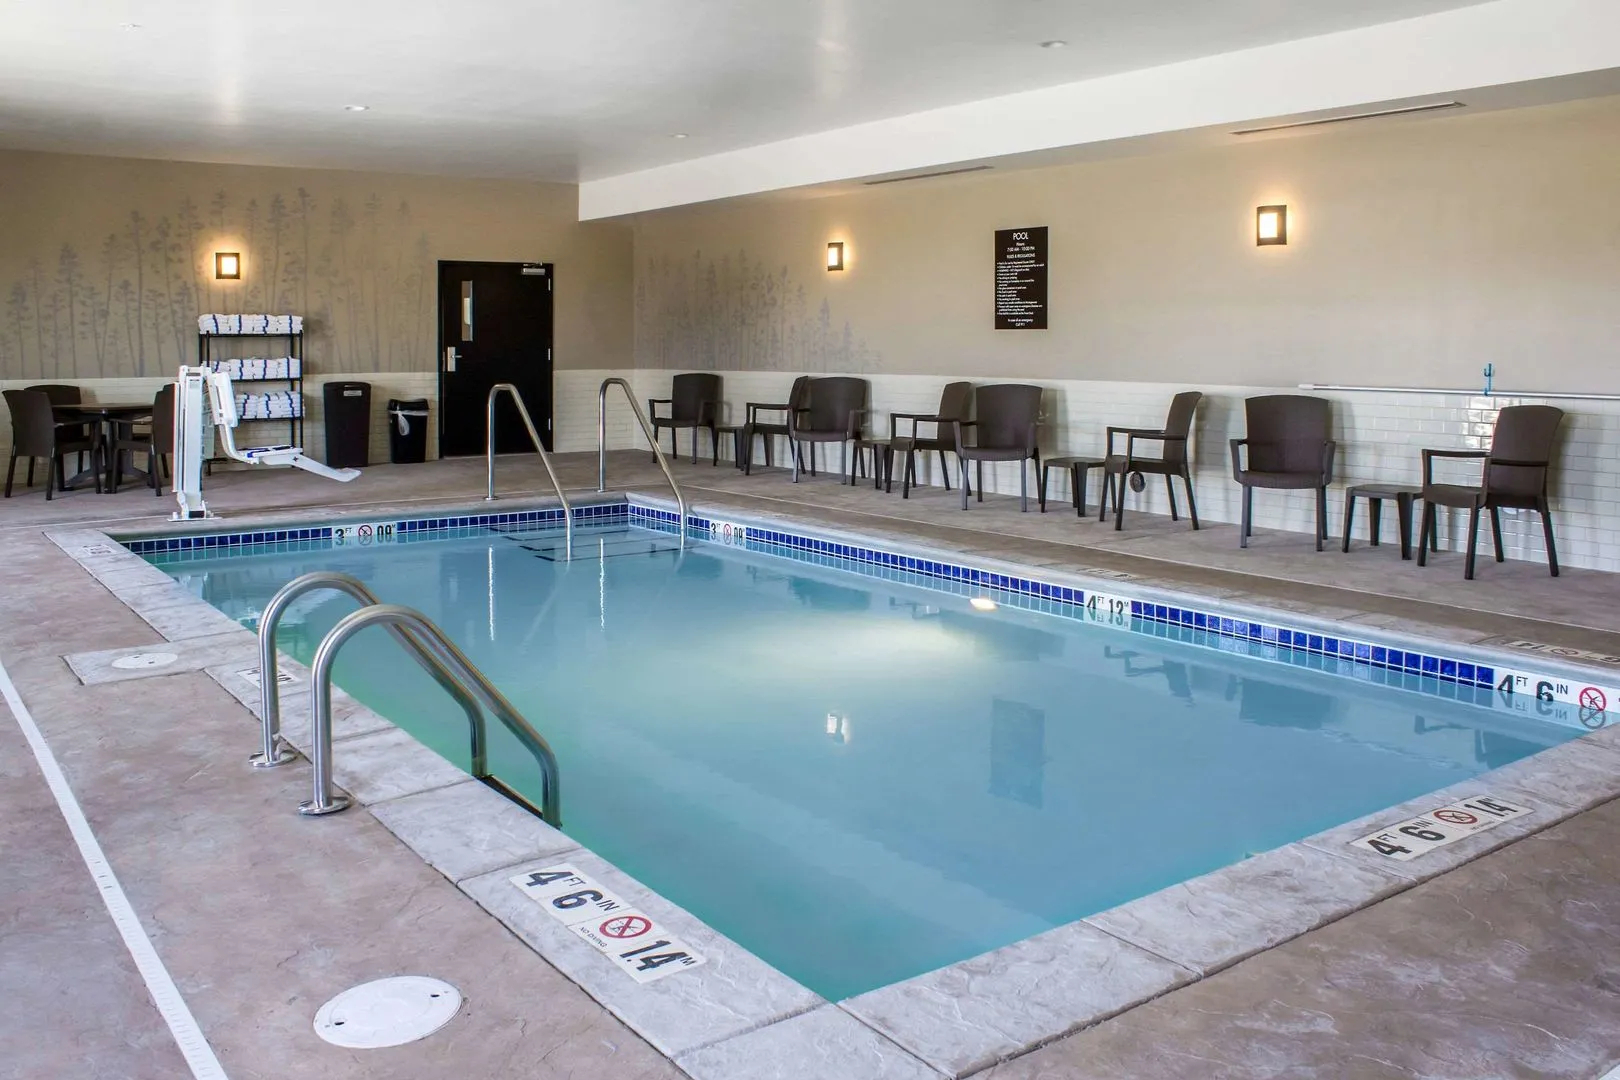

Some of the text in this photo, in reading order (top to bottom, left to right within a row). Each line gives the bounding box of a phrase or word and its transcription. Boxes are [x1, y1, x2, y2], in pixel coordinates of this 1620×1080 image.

[1012, 232, 1029, 240] POOL
[1497, 674, 1568, 701] 4 FT 6 IN
[1377, 833, 1397, 842] FT
[1399, 826, 1446, 841] 6
[1367, 839, 1412, 856] 4
[526, 870, 620, 912] 4 FT 6 IN
[587, 932, 608, 948] DIVING
[619, 940, 697, 972] 1.4 M
